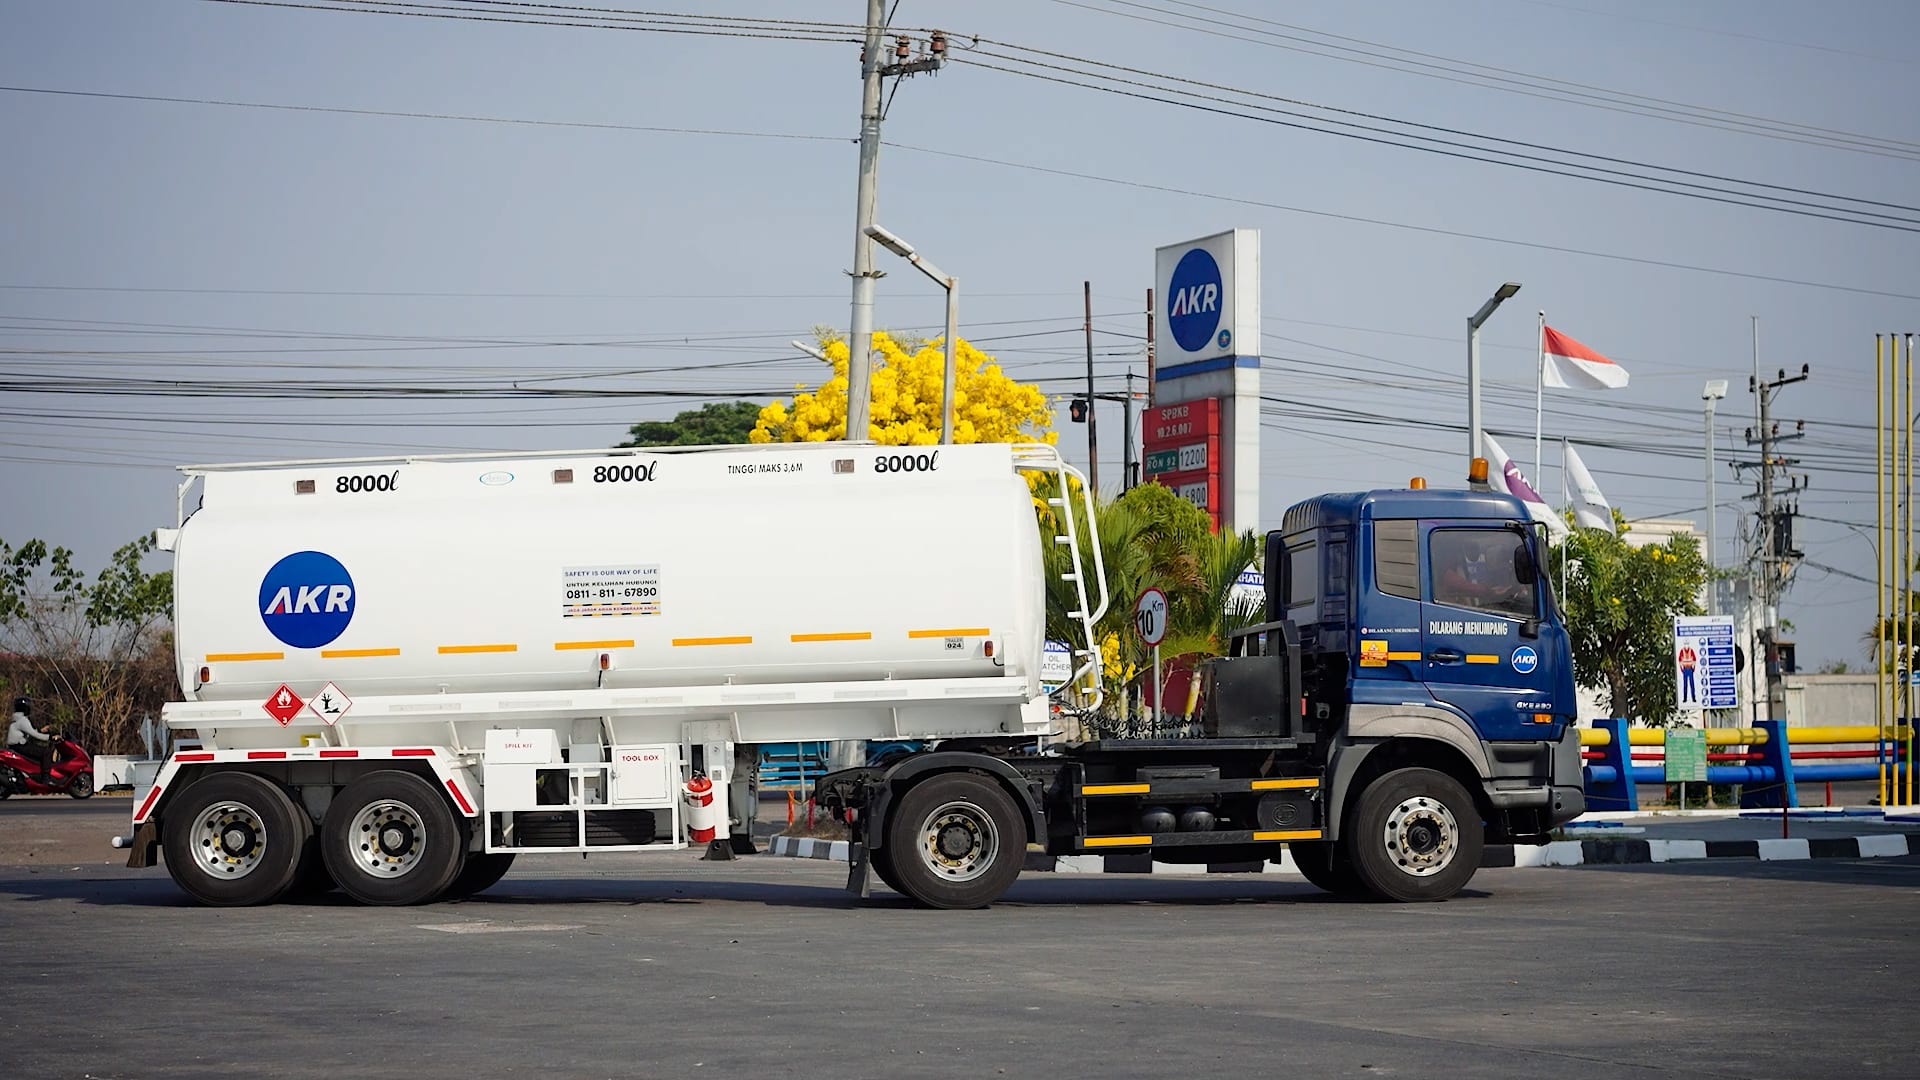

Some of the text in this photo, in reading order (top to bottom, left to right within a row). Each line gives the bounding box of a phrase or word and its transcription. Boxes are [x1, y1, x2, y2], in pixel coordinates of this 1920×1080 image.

[1171, 283, 1217, 317] AKR
[1162, 406, 1189, 420] SPBKB
[1147, 456, 1176, 470] RON 92
[1180, 448, 1206, 467] 12200
[728, 463, 803, 474] TINGGI MAKS 3,6M
[264, 585, 352, 614] AKR
[566, 590, 590, 599] 0811
[600, 589, 615, 598] 811
[624, 587, 657, 597] 67890
[1138, 601, 1164, 636] 10 Km
[1430, 621, 1508, 635] DILARANG MENUMPANG
[1513, 655, 1536, 665] AKR
